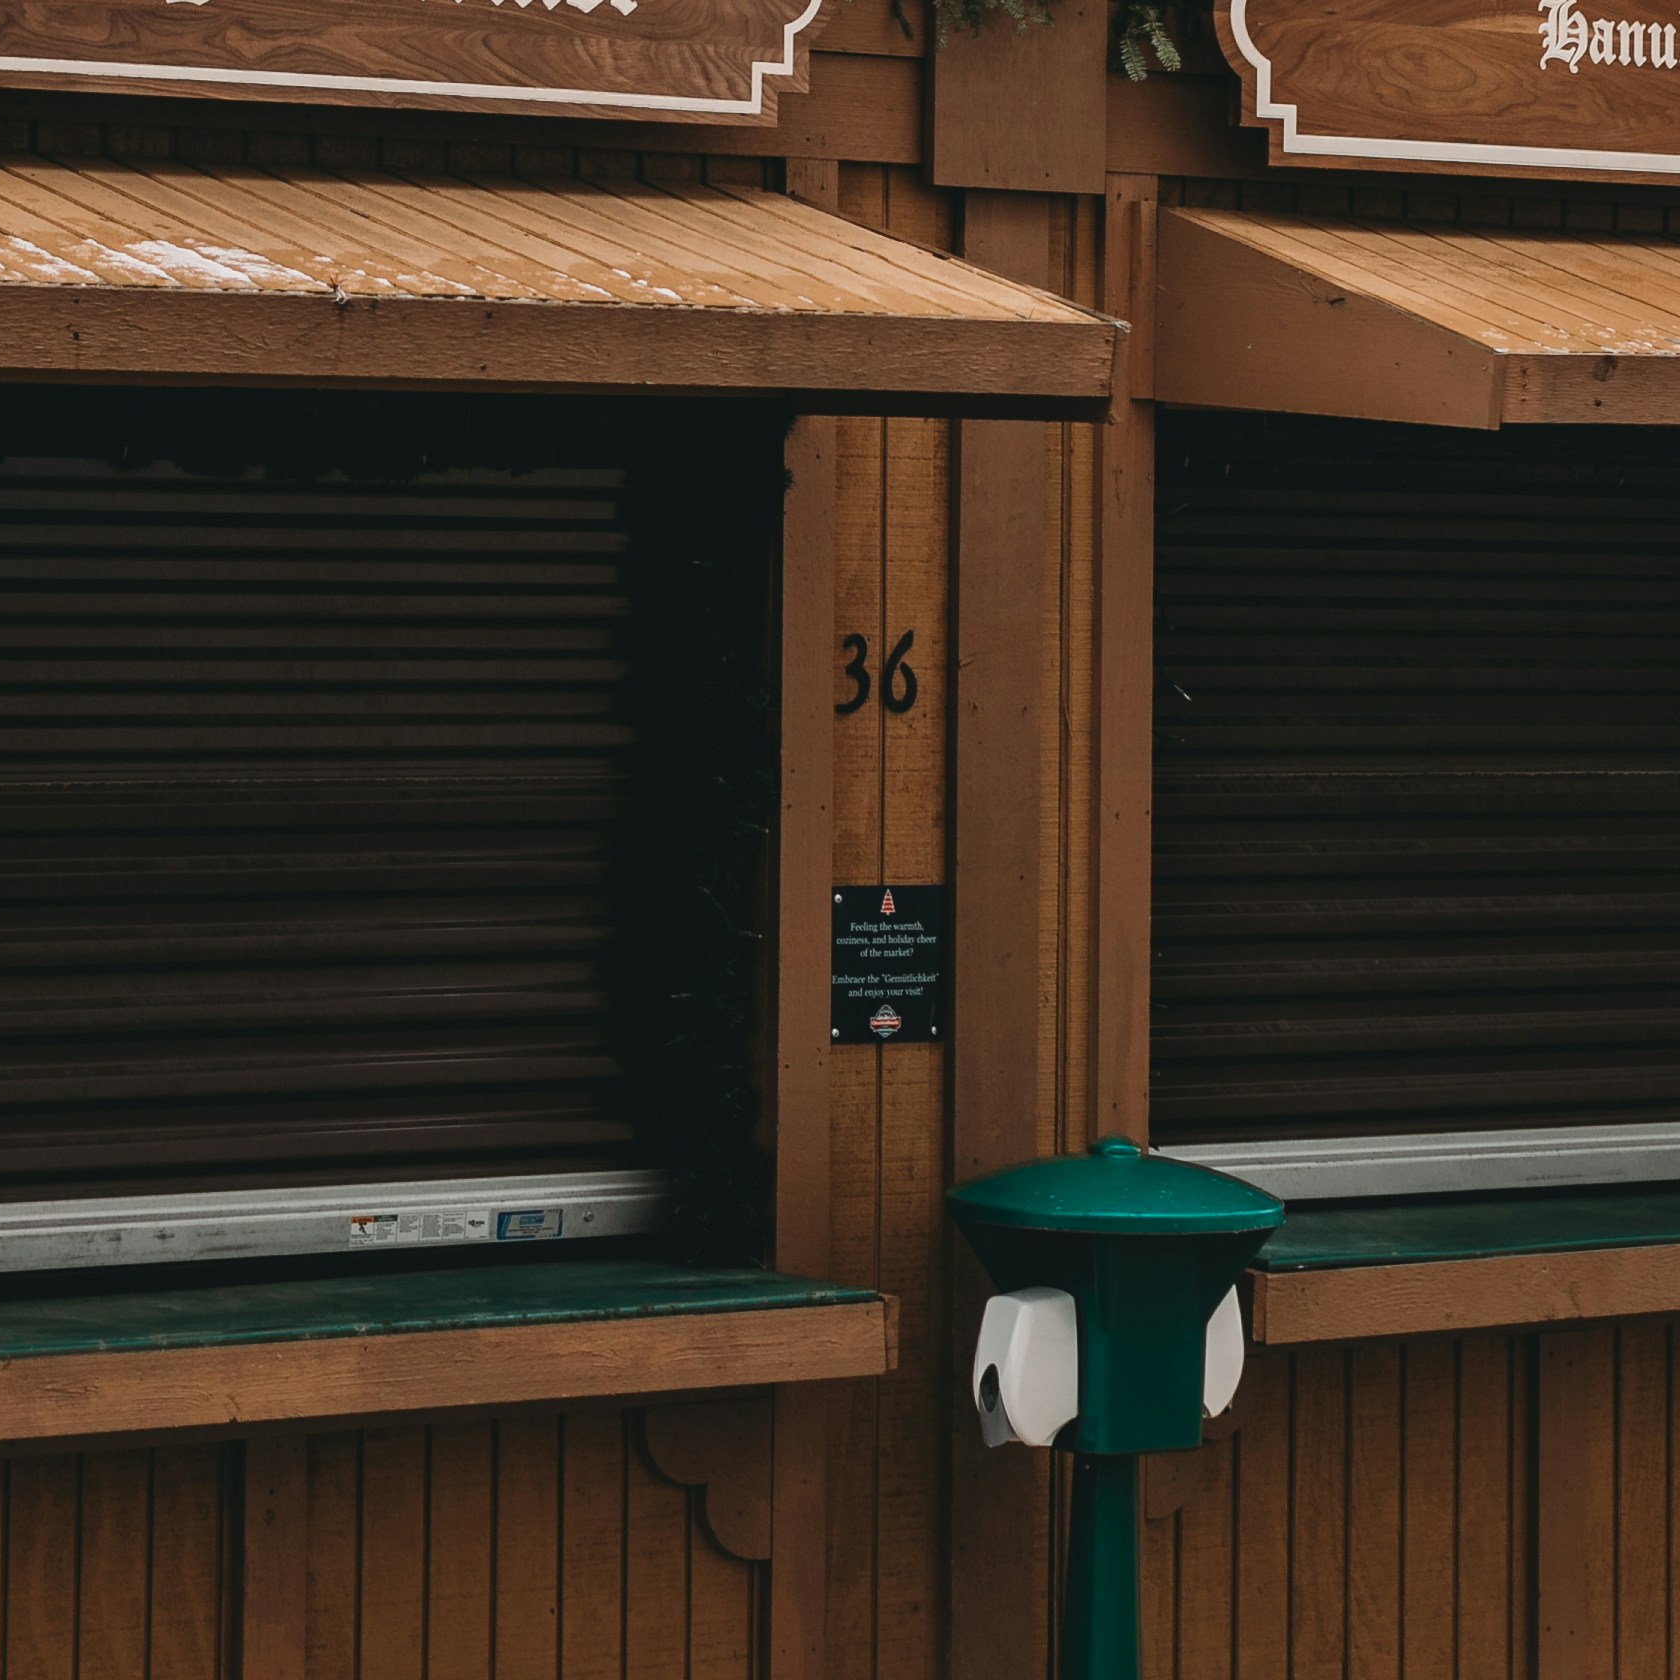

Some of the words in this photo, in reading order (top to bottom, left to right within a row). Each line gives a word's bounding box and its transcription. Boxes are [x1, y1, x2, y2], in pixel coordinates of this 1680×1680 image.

[835, 629, 918, 714] 36
[850, 921, 878, 932] Feeling
[879, 921, 892, 931] the
[893, 921, 924, 931] warmth,
[836, 935, 870, 945] coziness,
[872, 934, 887, 944] and
[888, 934, 915, 946] holiday
[916, 934, 936, 944] cheer
[860, 948, 869, 958] of
[870, 948, 882, 957] the
[883, 947, 914, 957] market?
[832, 974, 865, 984] Embrace
[867, 974, 880, 983] the
[848, 988, 863, 997] and
[864, 988, 884, 998] enjoy
[886, 988, 904, 998] your
[905, 987, 924, 996] visit!
